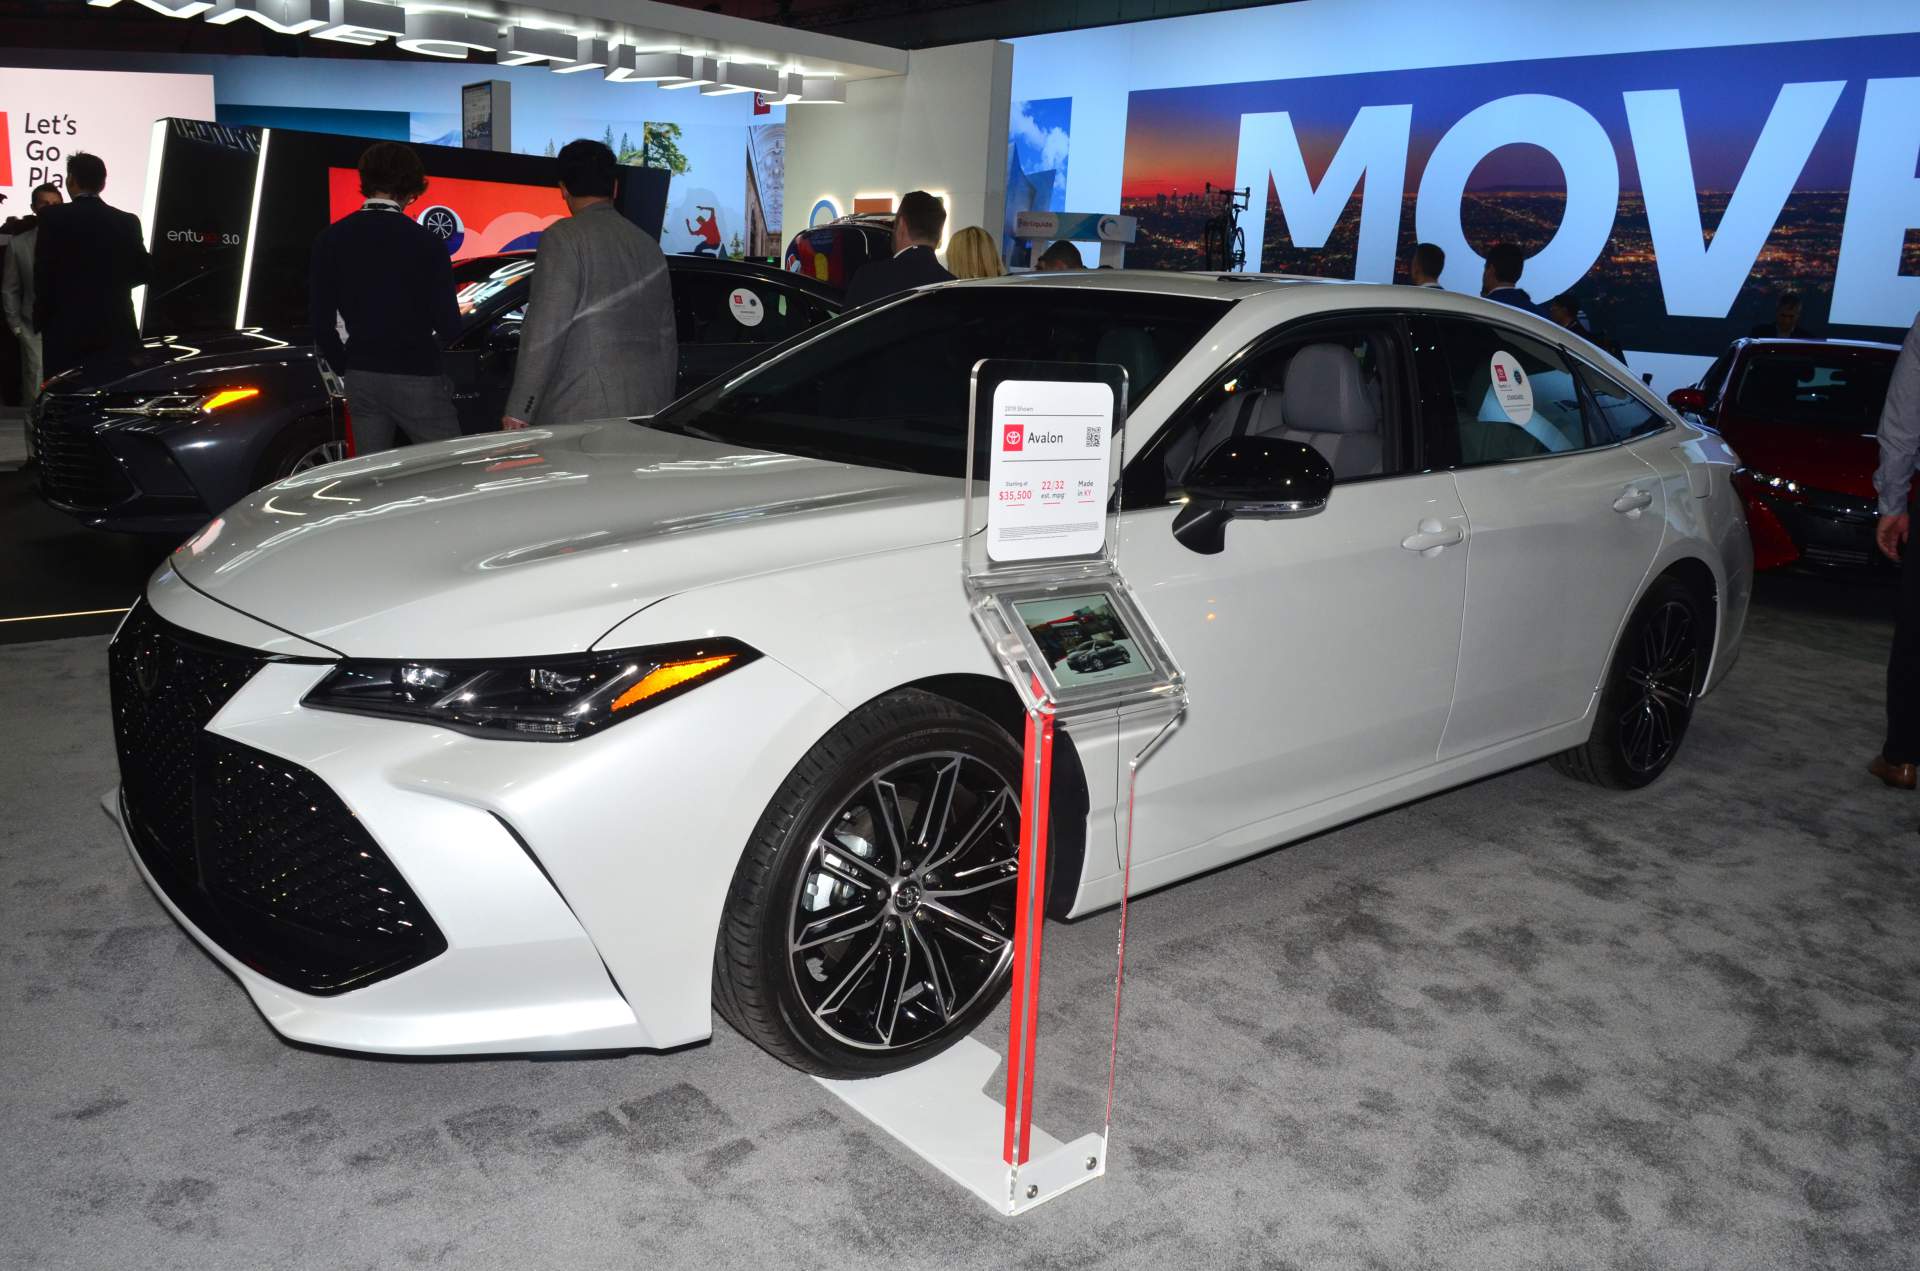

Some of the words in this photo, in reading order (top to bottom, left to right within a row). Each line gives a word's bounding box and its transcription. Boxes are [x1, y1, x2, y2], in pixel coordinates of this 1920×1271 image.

[24, 112, 77, 136] Let's
[26, 139, 61, 162] Go
[1236, 77, 1920, 329] MOVE
[222, 233, 240, 246] 3.0
[1027, 431, 1064, 444] Avalon
[1042, 480, 1065, 490] 22/32
[999, 490, 1032, 501] $35,500
